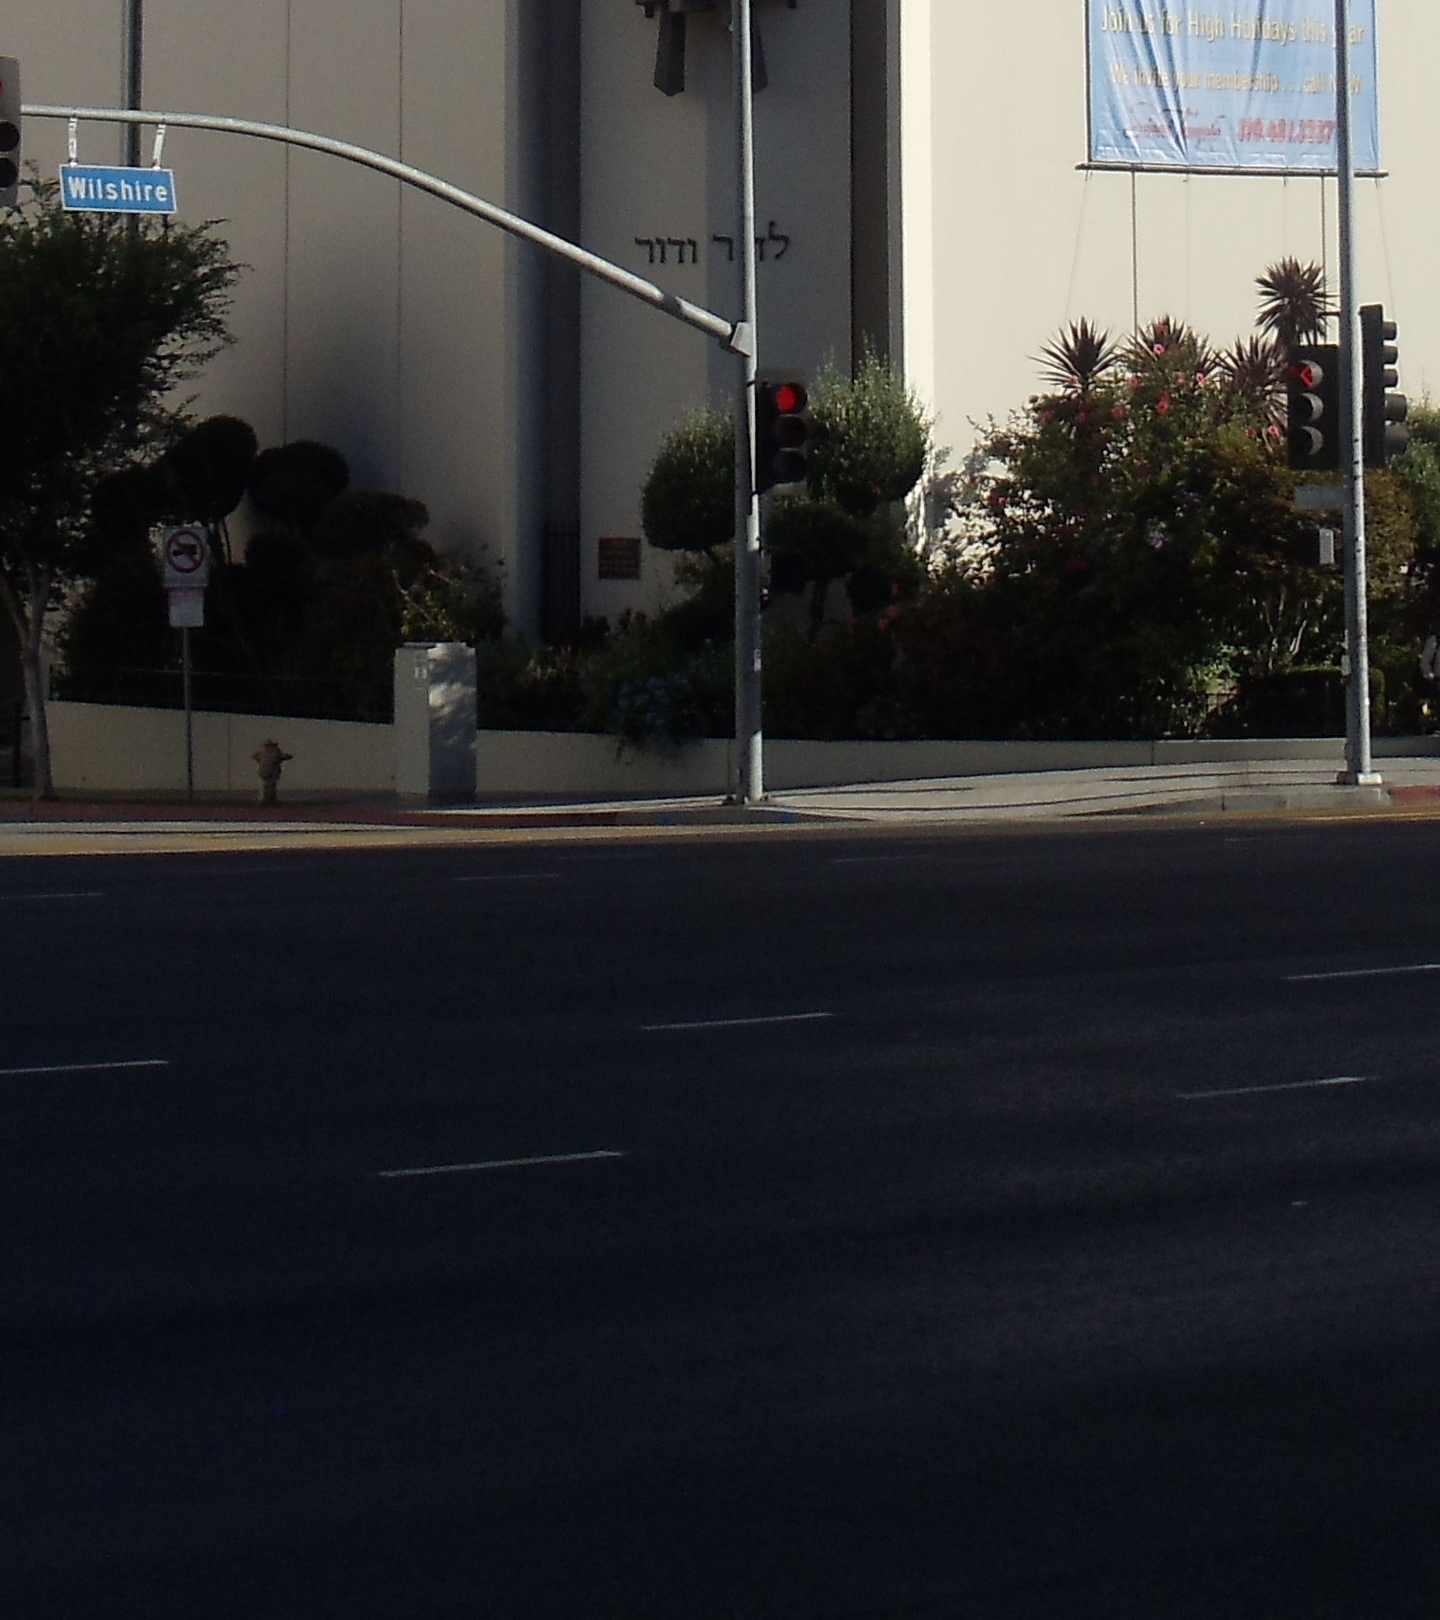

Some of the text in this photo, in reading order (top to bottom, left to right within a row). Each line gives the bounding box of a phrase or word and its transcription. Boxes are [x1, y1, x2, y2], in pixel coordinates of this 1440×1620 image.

[1101, 4, 1366, 48] Join us for High Holidays this ar
[1112, 62, 1129, 85] We
[1134, 65, 1168, 87] invite
[1172, 71, 1201, 93] your
[1303, 72, 1325, 94] call
[1329, 73, 1361, 94] NW
[68, 176, 168, 202] Wilshire
[635, 237, 697, 264] ודור
